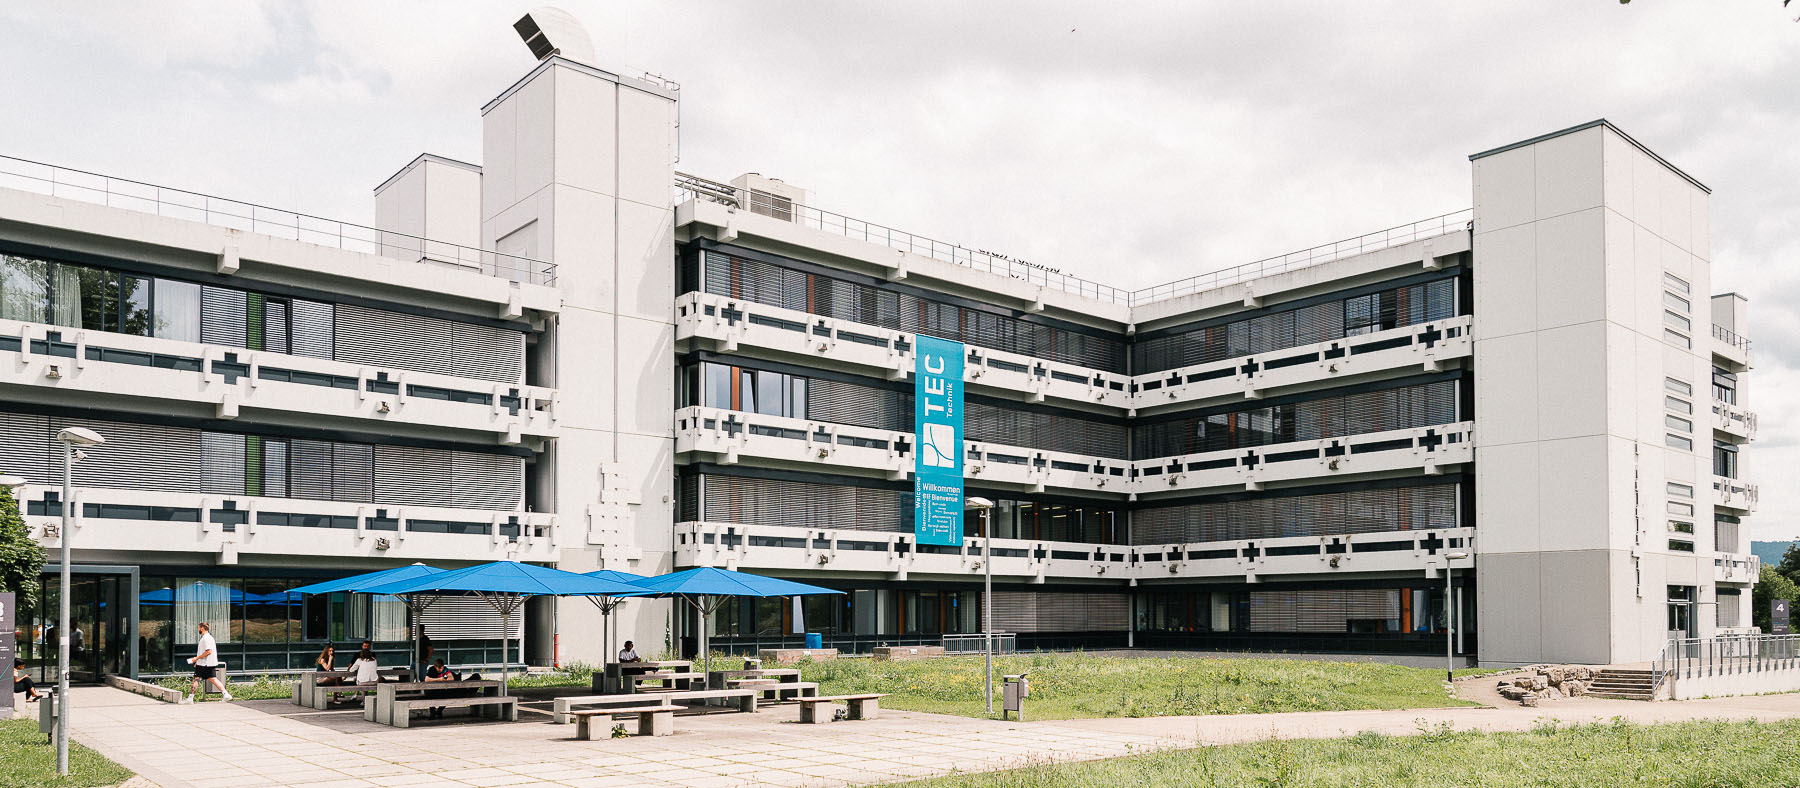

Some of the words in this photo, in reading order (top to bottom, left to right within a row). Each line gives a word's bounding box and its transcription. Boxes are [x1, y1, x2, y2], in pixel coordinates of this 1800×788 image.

[925, 354, 944, 416] TEC
[922, 483, 960, 494] Willkommen
[1776, 604, 1784, 612] 4
